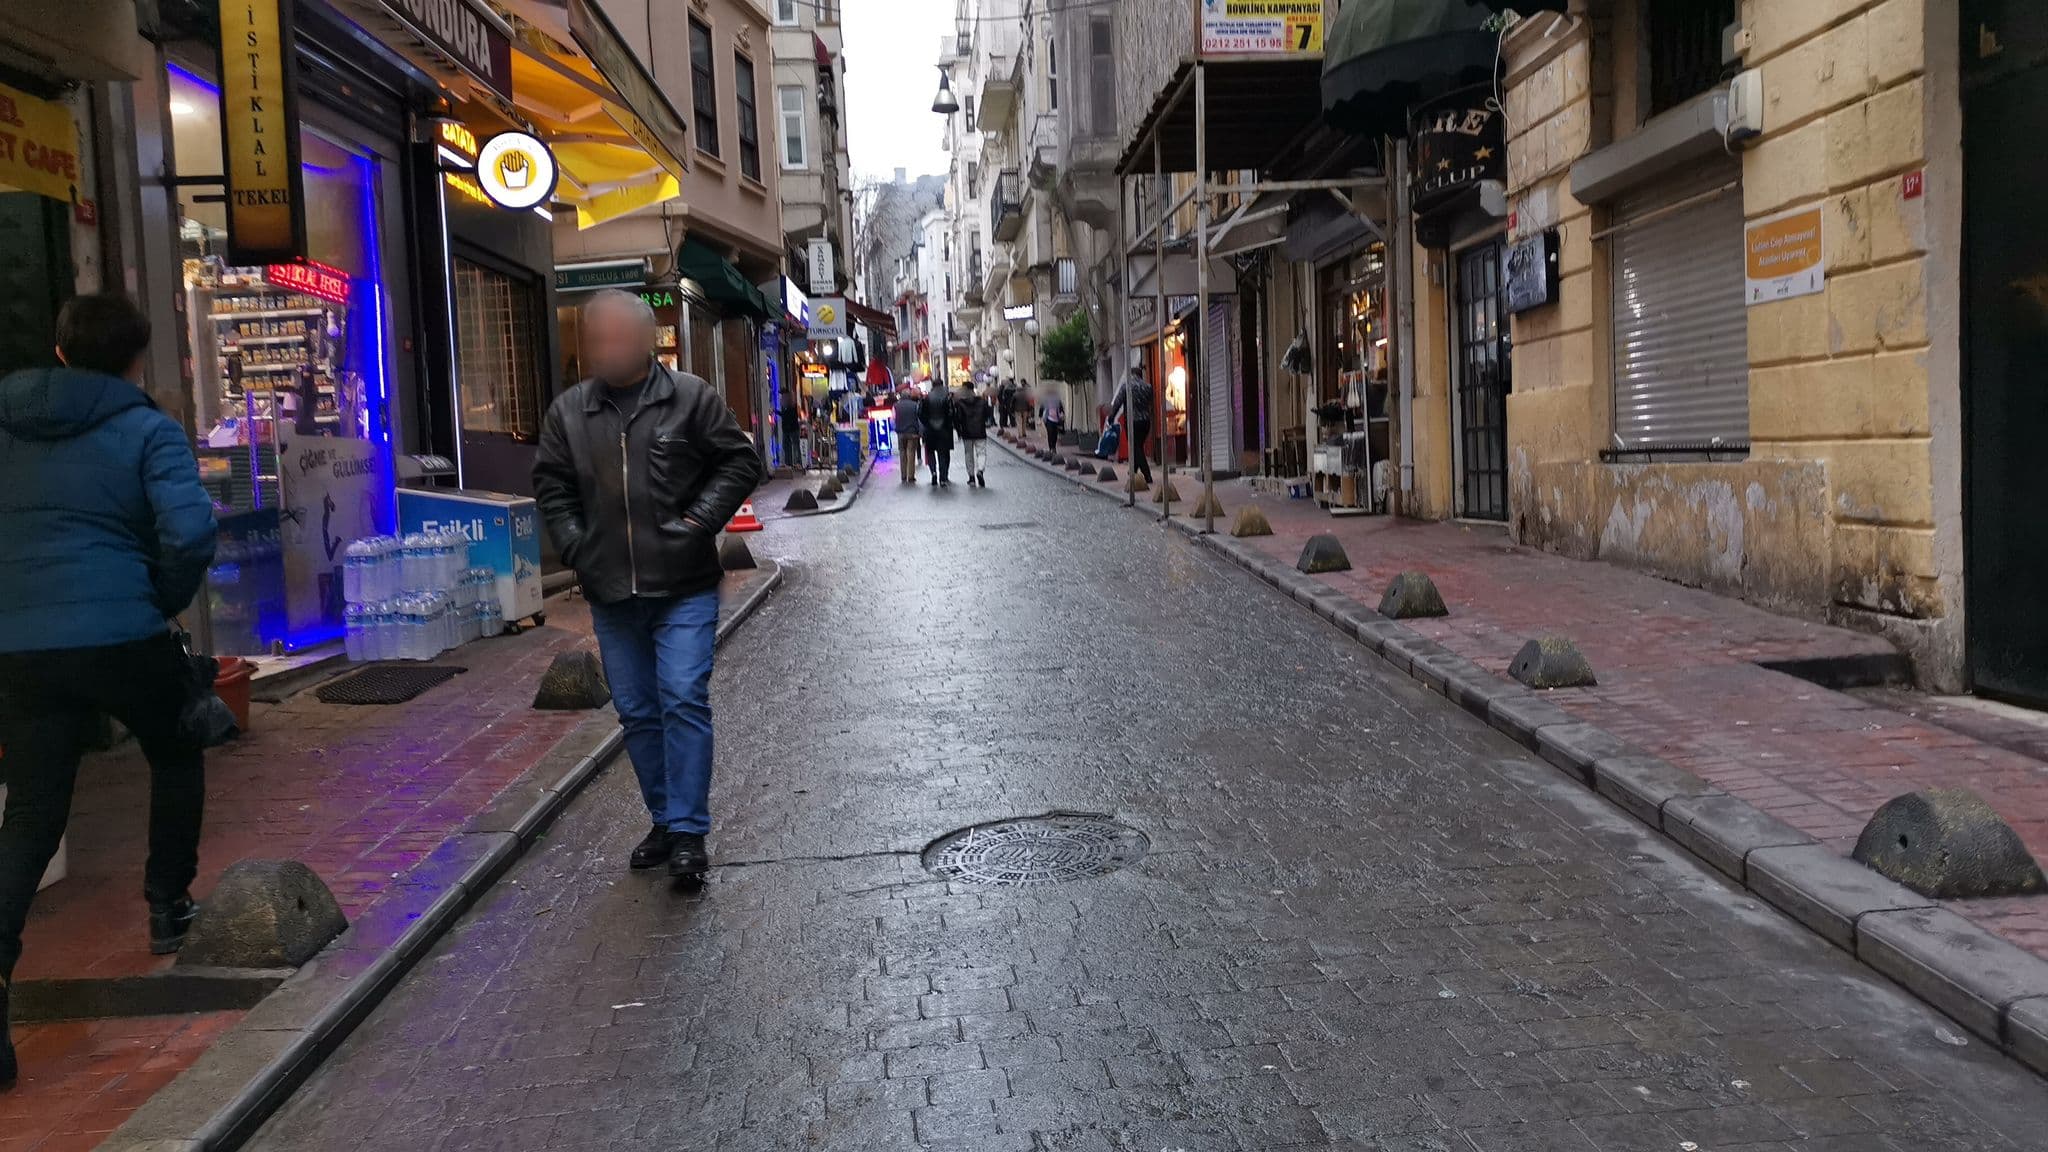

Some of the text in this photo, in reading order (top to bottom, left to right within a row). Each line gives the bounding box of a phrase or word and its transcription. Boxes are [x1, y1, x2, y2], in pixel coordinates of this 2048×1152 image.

[401, 0, 493, 78] NDURA
[1205, 38, 1230, 48] 0212
[1295, 24, 1313, 50] 7
[246, 4, 269, 176] İSTİKLAL
[23, 140, 77, 181] CAFE
